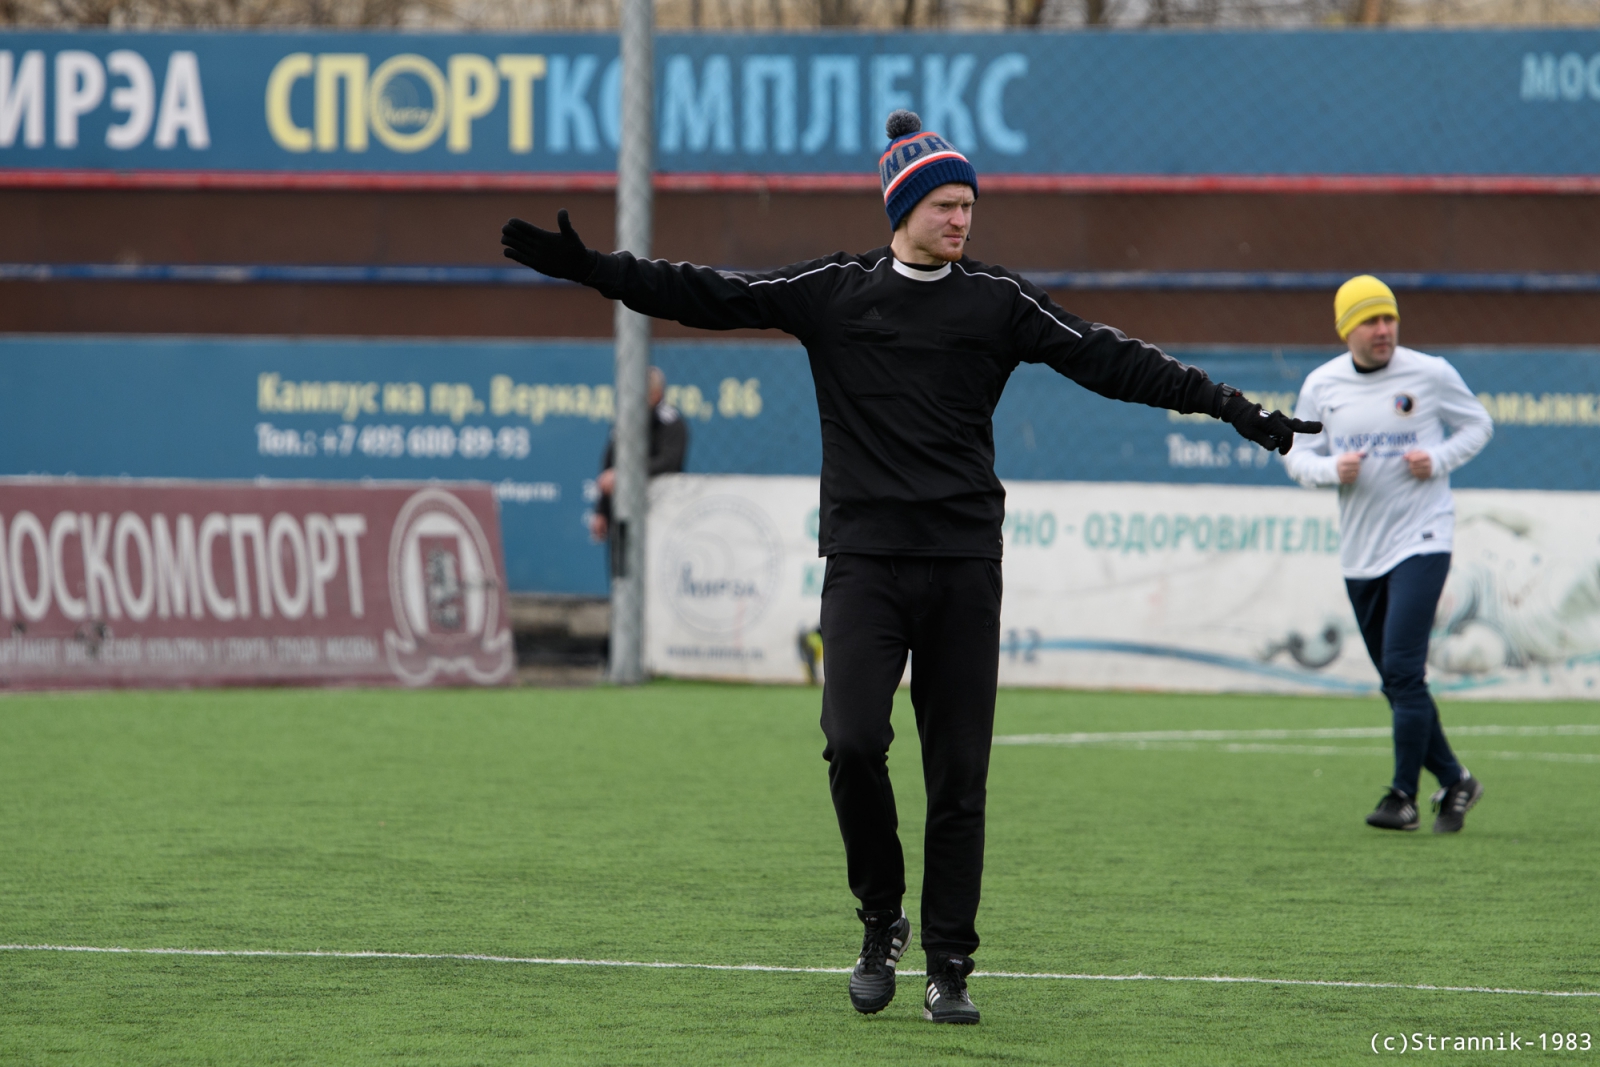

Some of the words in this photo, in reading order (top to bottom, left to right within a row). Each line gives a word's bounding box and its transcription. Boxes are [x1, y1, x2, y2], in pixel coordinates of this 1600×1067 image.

[257, 371, 380, 421] Кампус
[382, 381, 426, 415] на
[430, 381, 486, 424] пр.
[717, 377, 763, 419] 86
